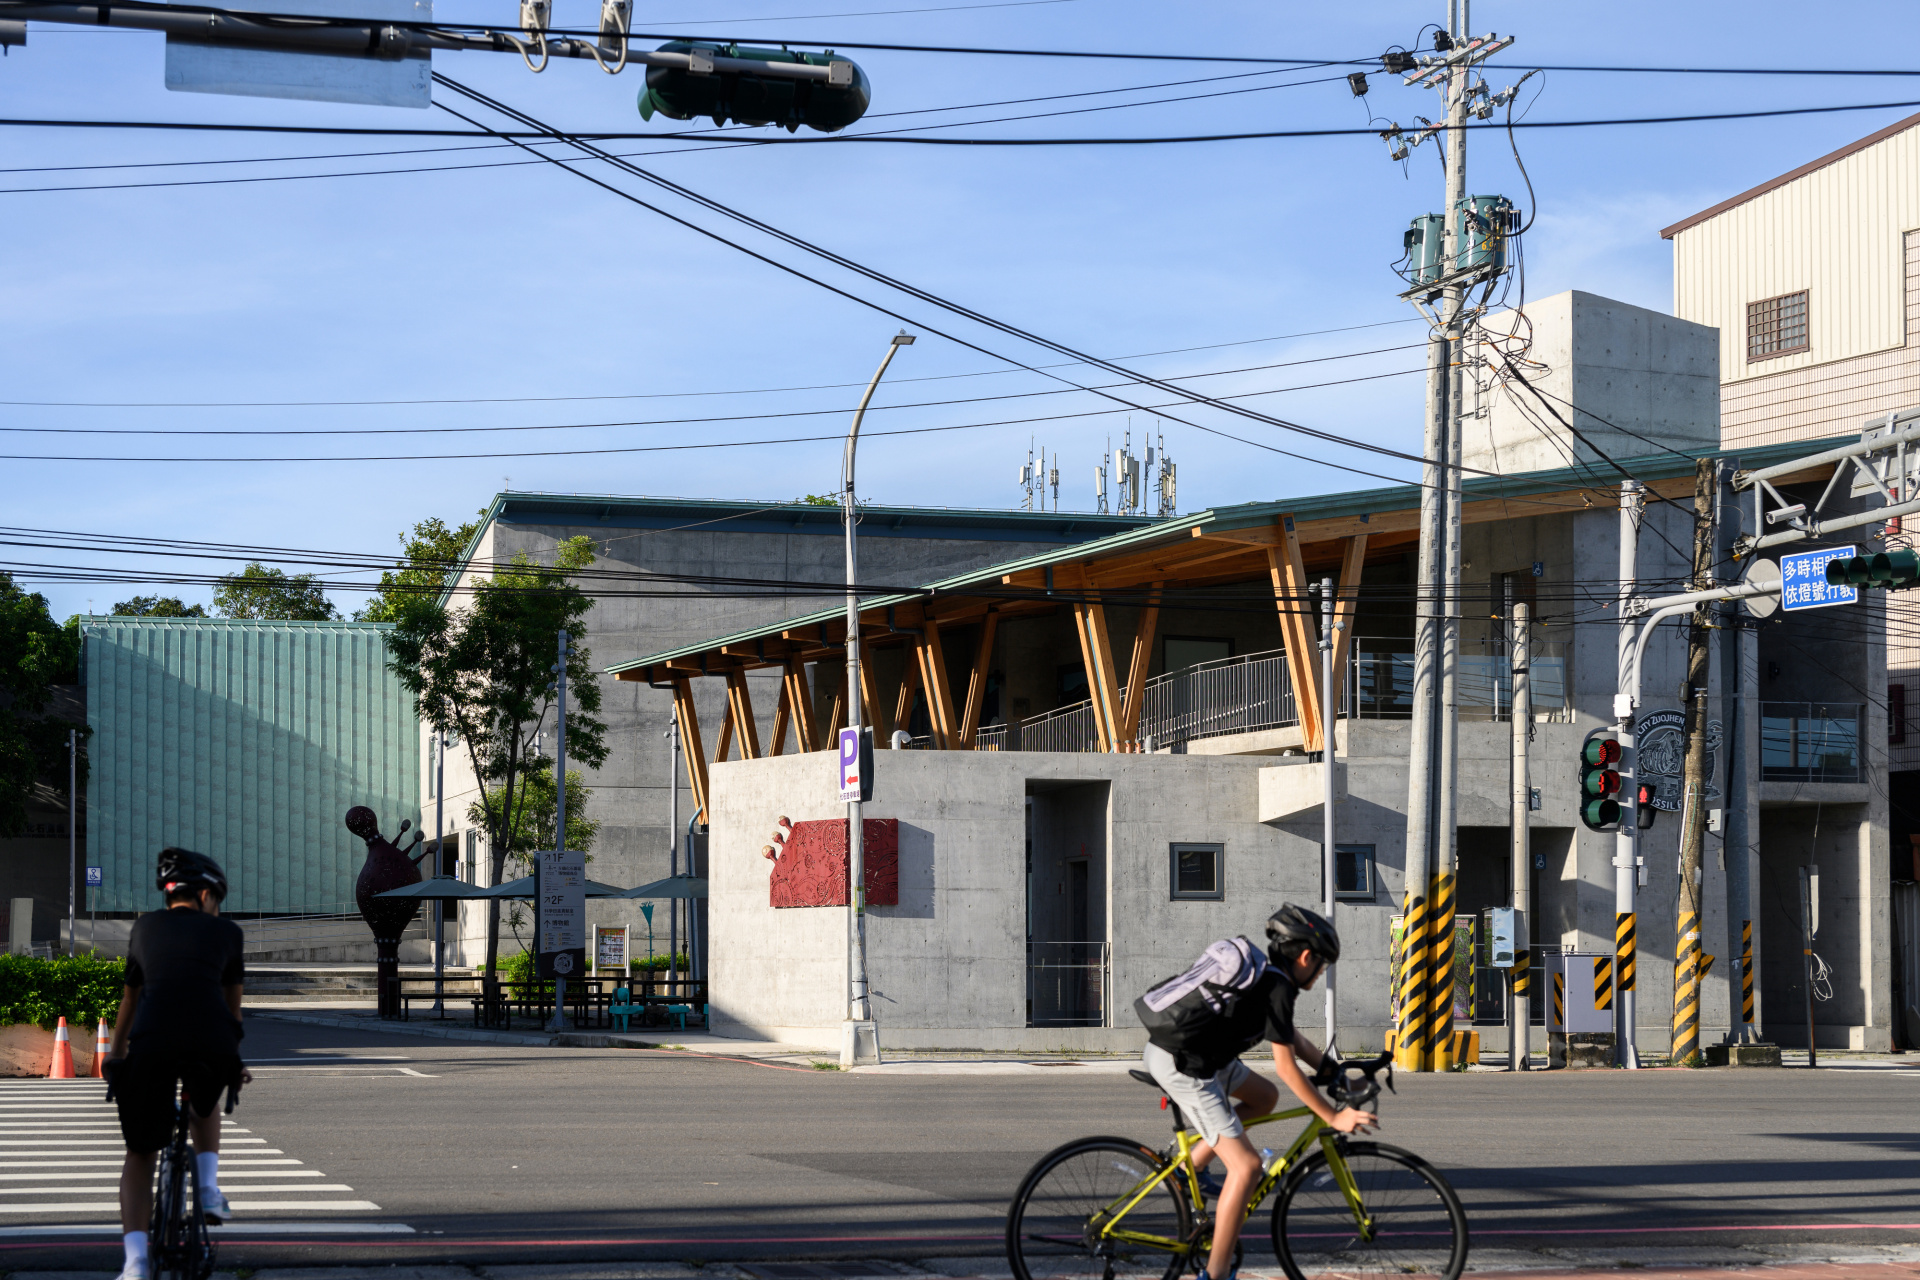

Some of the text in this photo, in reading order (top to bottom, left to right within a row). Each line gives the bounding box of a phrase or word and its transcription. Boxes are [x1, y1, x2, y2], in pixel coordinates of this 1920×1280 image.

[840, 729, 858, 790] P
[552, 853, 564, 862] 1F
[551, 895, 564, 905] 2F
